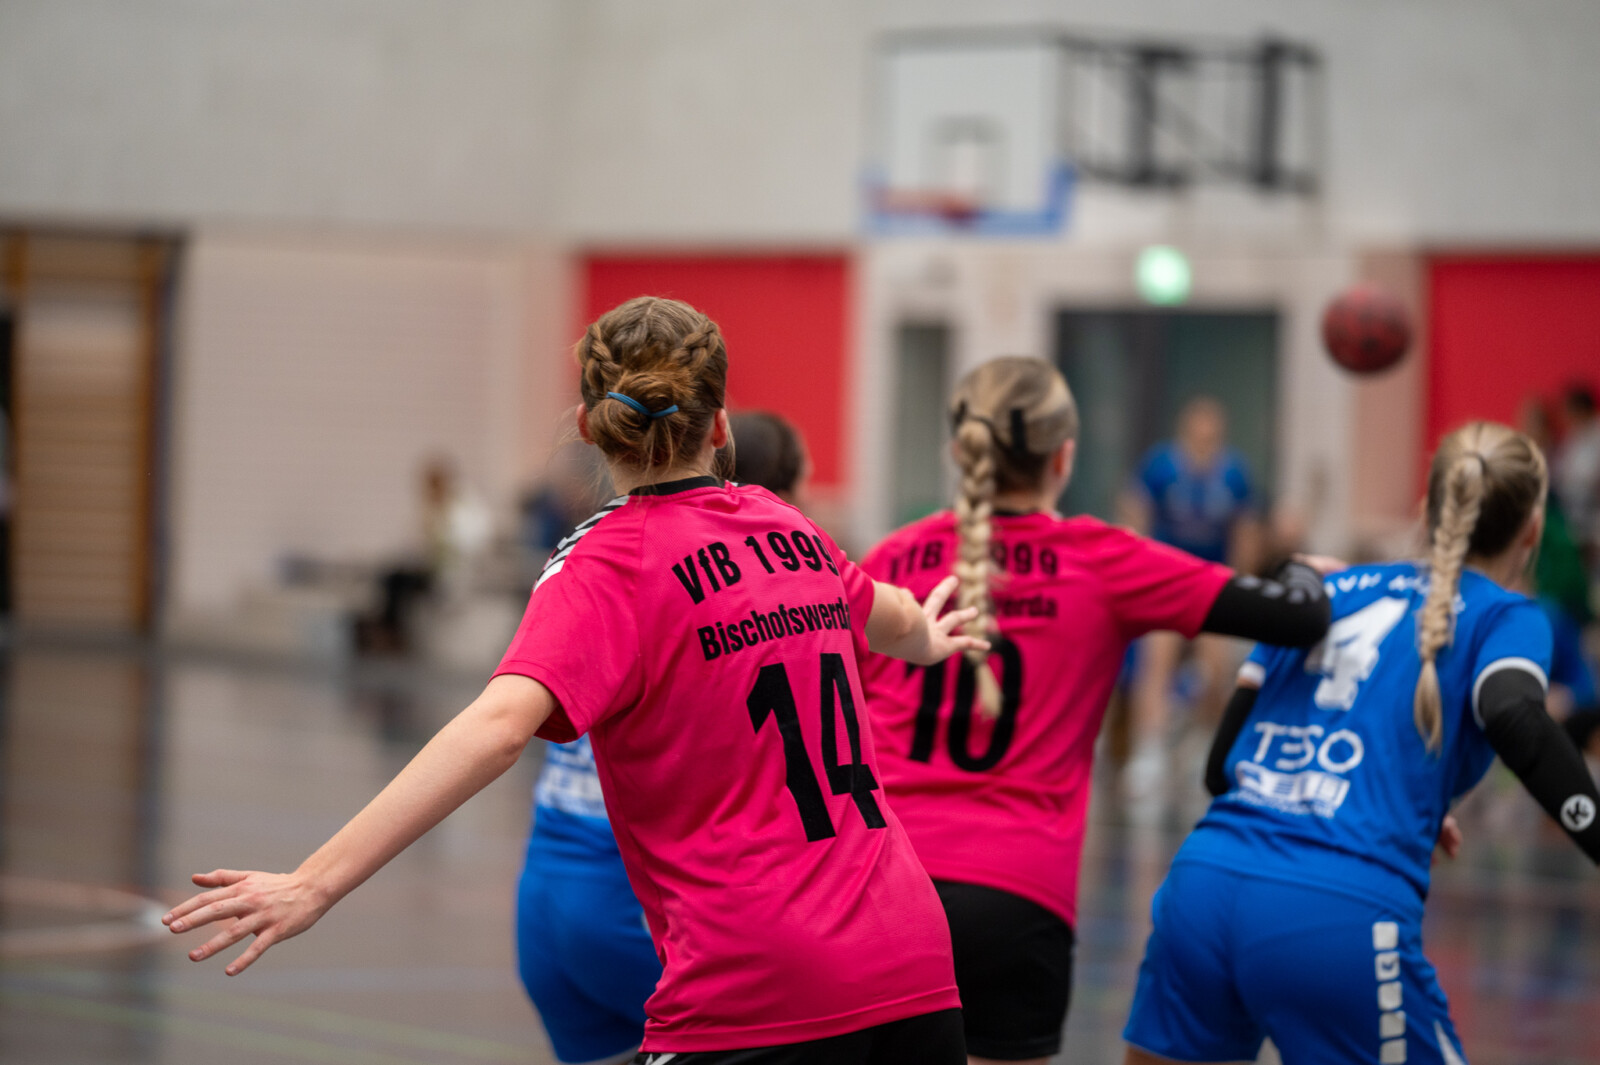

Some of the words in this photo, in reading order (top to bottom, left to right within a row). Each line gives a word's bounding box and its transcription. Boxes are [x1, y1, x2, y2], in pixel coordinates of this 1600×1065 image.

[672, 542, 741, 605] VfB
[744, 531, 839, 577] 1999
[746, 653, 887, 843] 14
[906, 632, 1023, 772] 10
